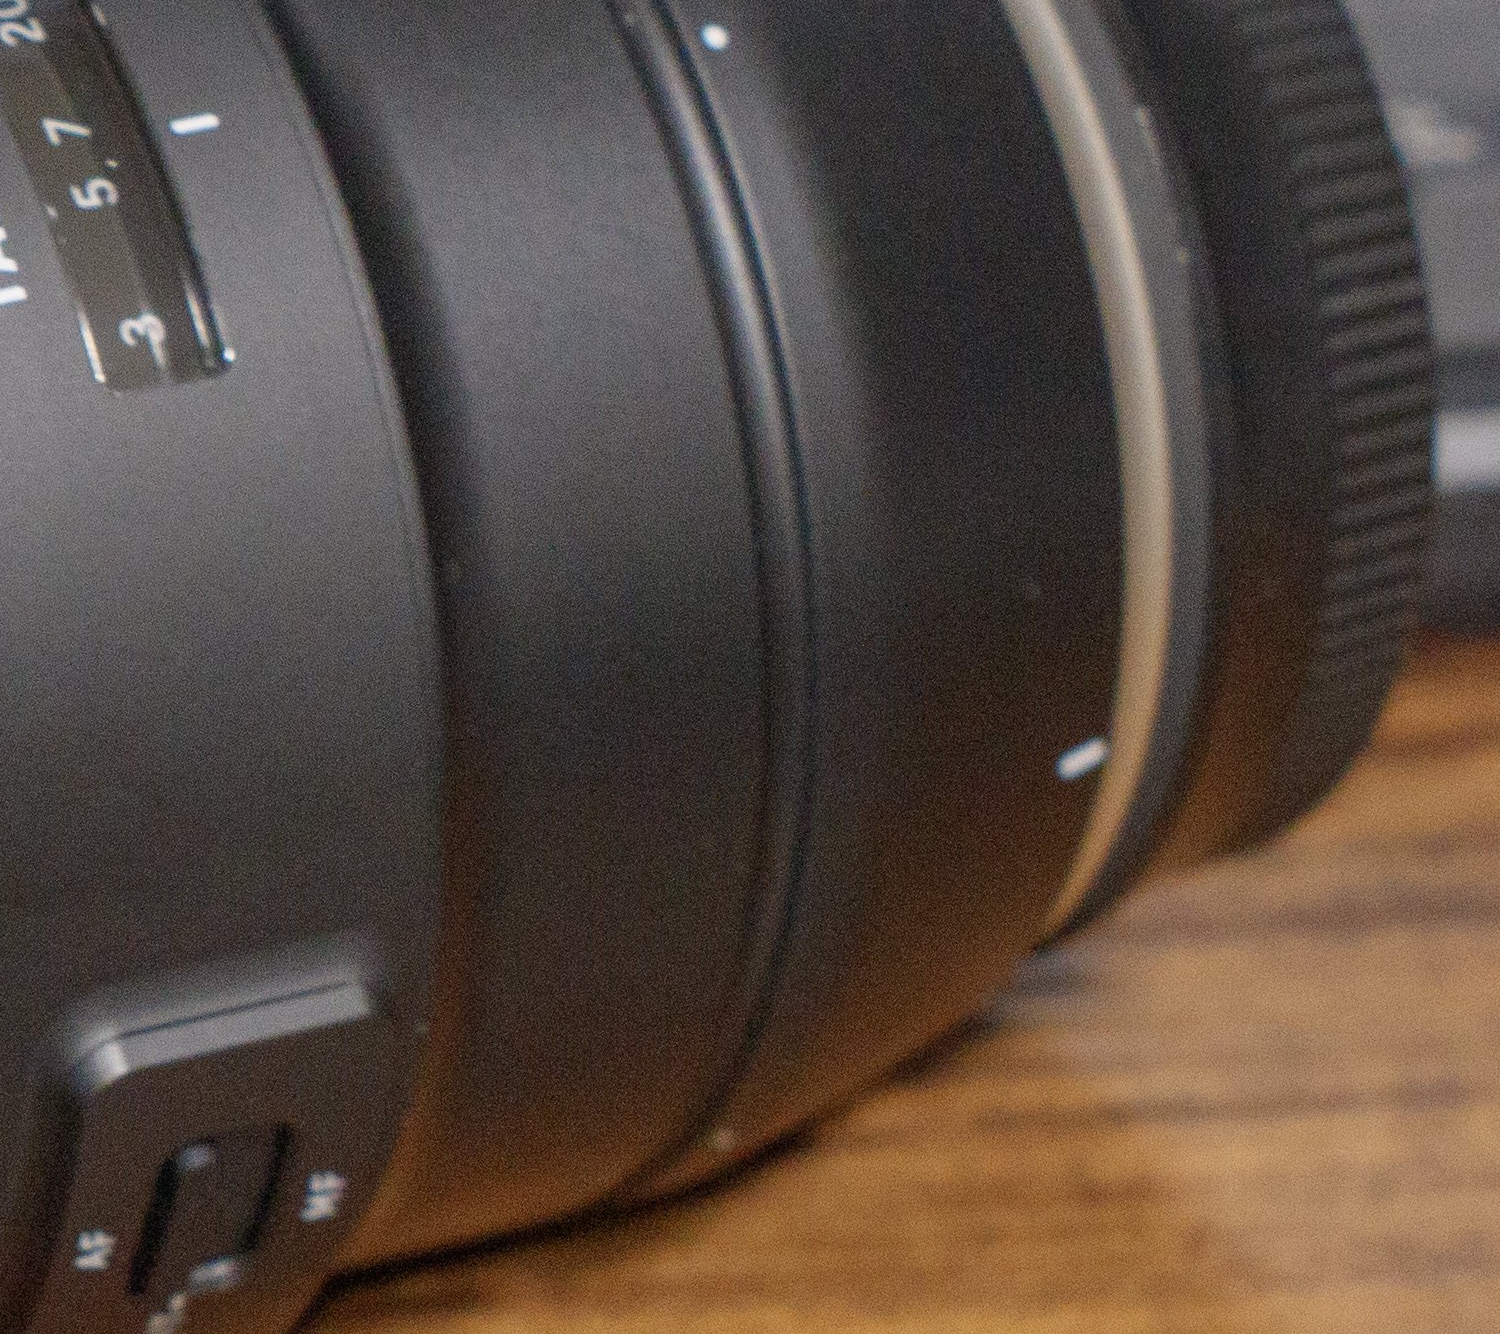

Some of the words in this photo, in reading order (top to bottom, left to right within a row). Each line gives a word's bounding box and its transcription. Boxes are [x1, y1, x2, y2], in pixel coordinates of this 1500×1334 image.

[41, 116, 91, 146] 7
[69, 176, 119, 211] 5
[119, 312, 166, 348] 3
